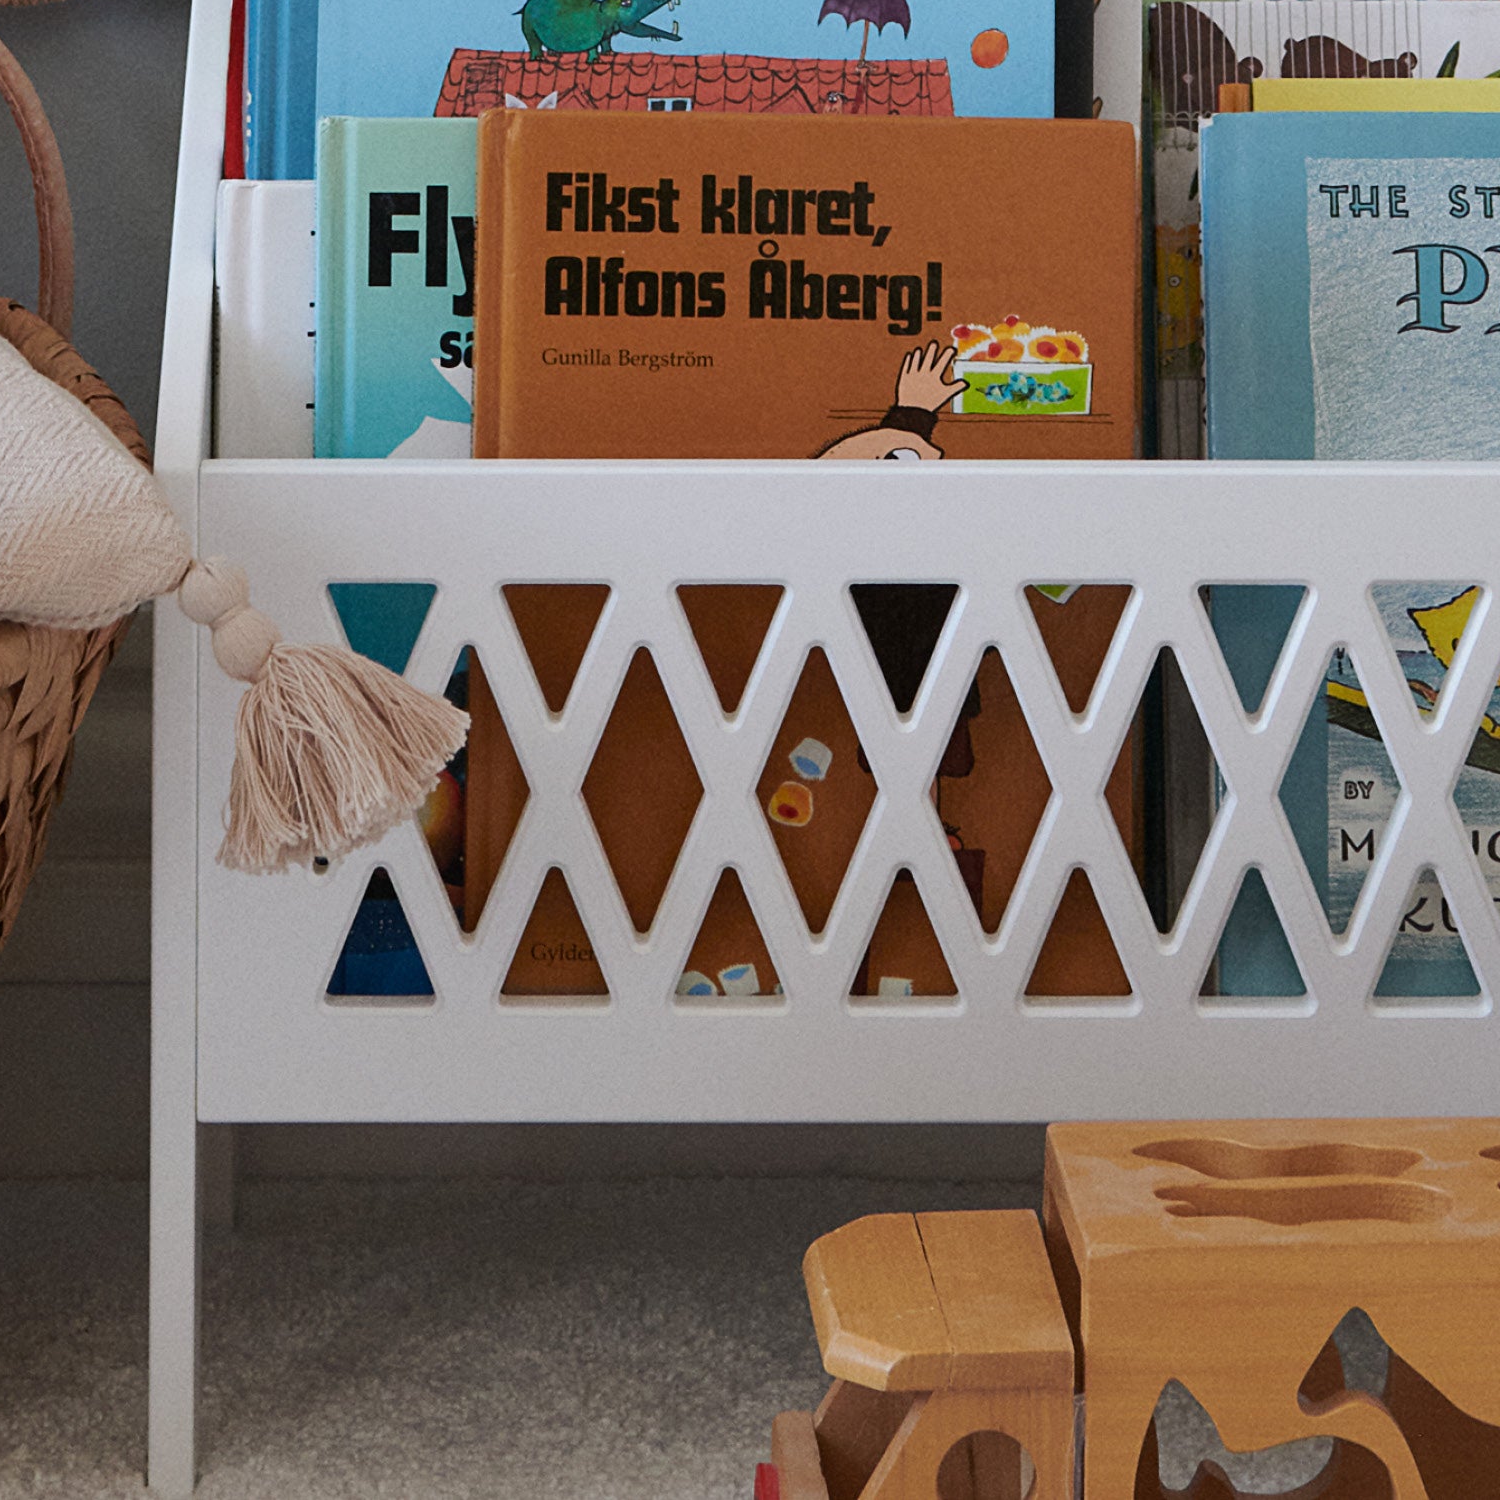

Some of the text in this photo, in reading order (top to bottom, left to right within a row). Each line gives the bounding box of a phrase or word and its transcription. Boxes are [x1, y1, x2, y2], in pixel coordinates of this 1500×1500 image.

[546, 172, 892, 247] Fikst klaret,
[1320, 184, 1410, 218] THE
[544, 239, 942, 335] Alfons Åberg!
[542, 348, 715, 371] Gunilla Bergström
[1344, 780, 1375, 800] BY
